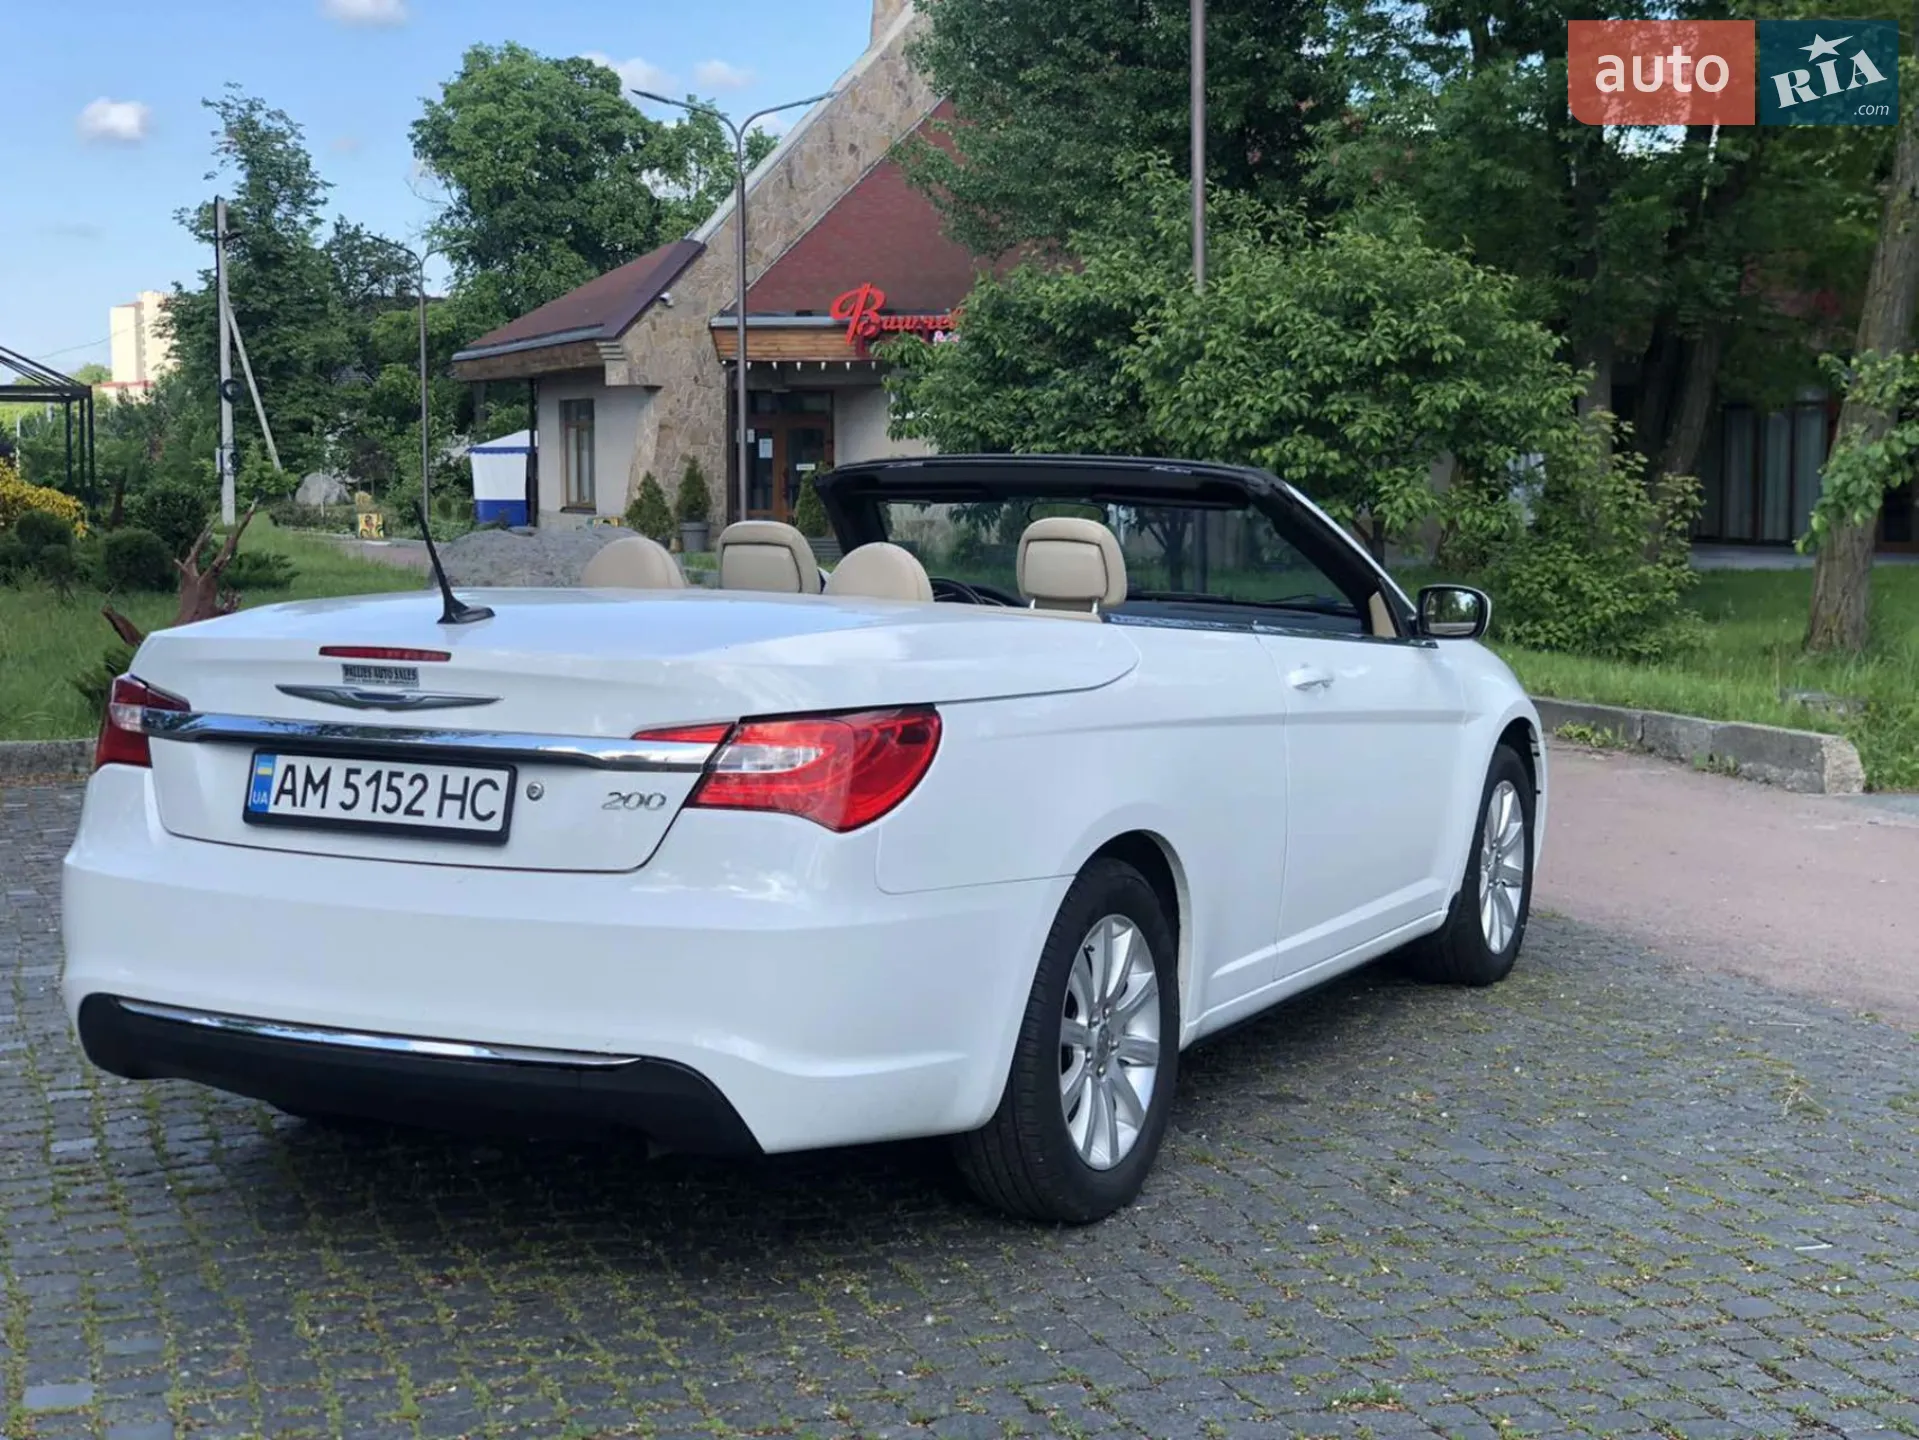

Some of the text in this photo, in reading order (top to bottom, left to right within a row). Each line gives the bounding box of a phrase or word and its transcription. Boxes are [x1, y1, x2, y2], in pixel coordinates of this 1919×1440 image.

[252, 791, 269, 805] UA
[273, 763, 500, 822] AM 5152 HC
[601, 791, 667, 811] 200
